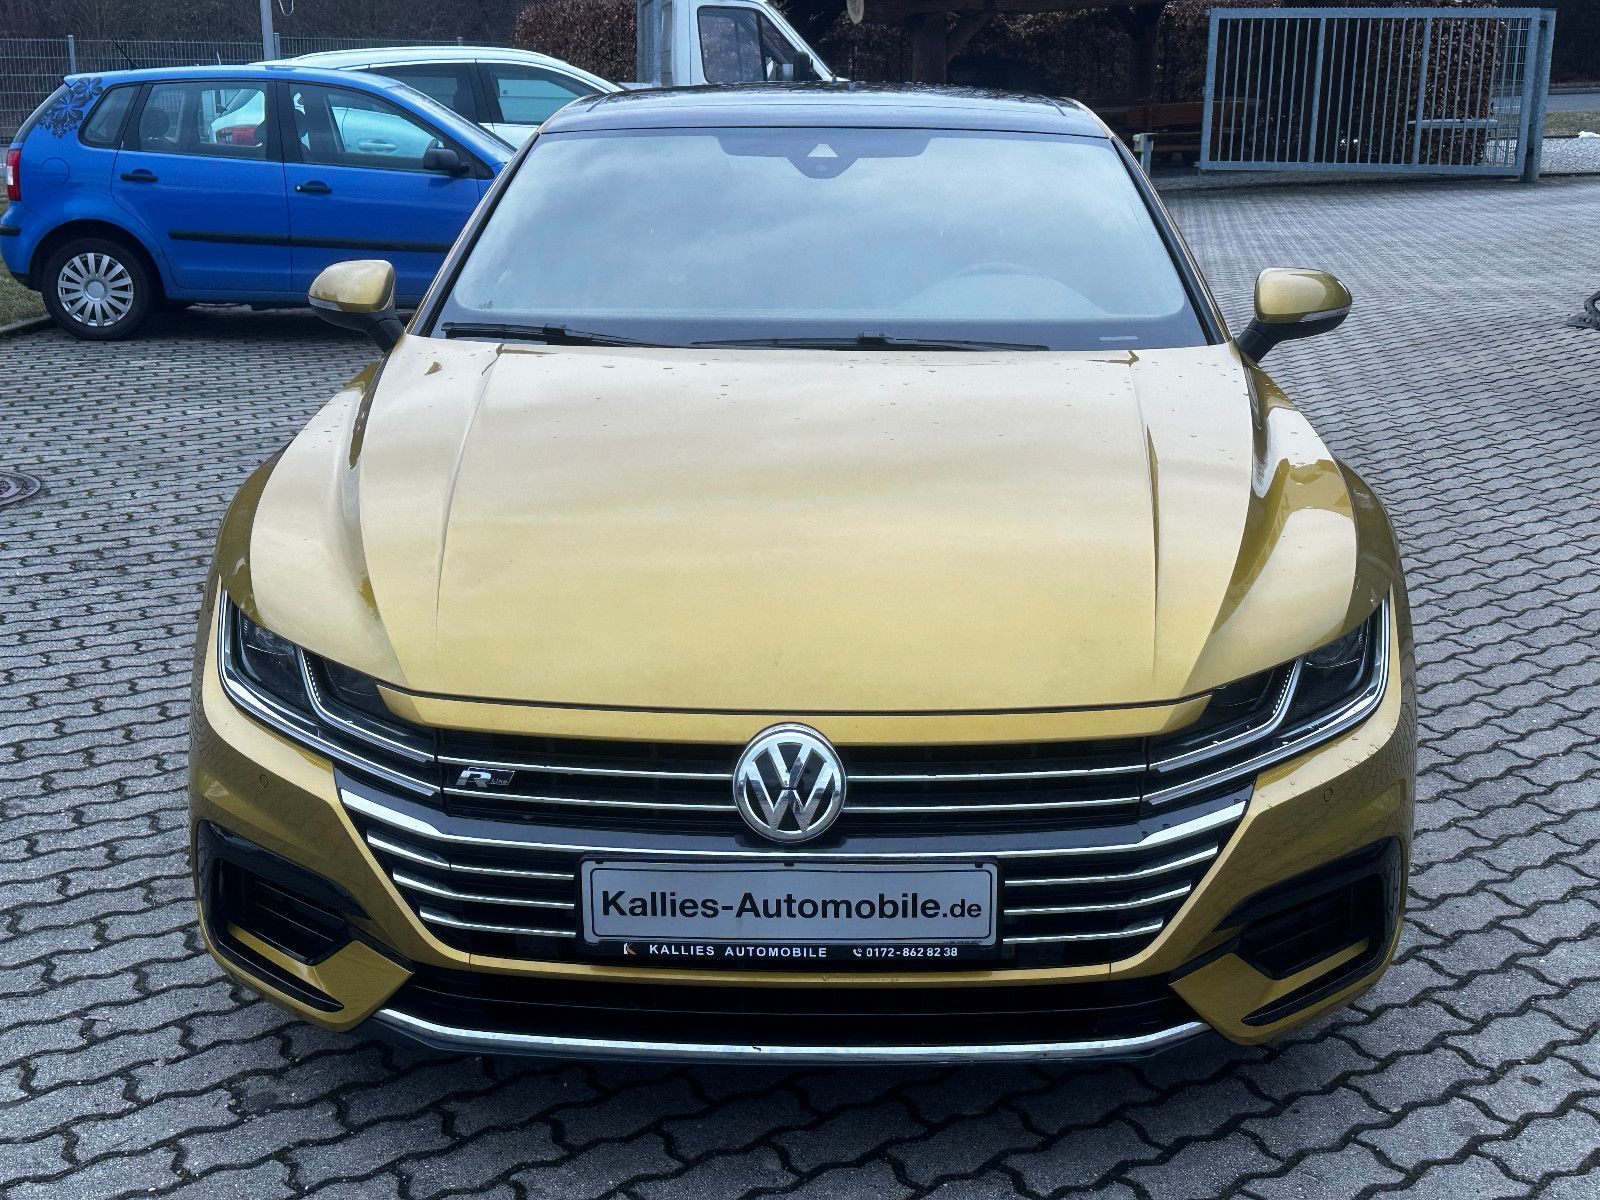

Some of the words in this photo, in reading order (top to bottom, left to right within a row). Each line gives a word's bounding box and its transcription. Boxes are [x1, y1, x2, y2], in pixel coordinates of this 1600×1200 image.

[456, 770, 491, 787] R
[738, 728, 842, 838] VW
[602, 890, 982, 919] Kallies-Automobile.de
[649, 944, 715, 956] KALLIES
[724, 946, 827, 958] AUTOMOBILE
[866, 947, 924, 958] 0172-862
[926, 947, 941, 958] 82
[943, 947, 958, 958] 38
